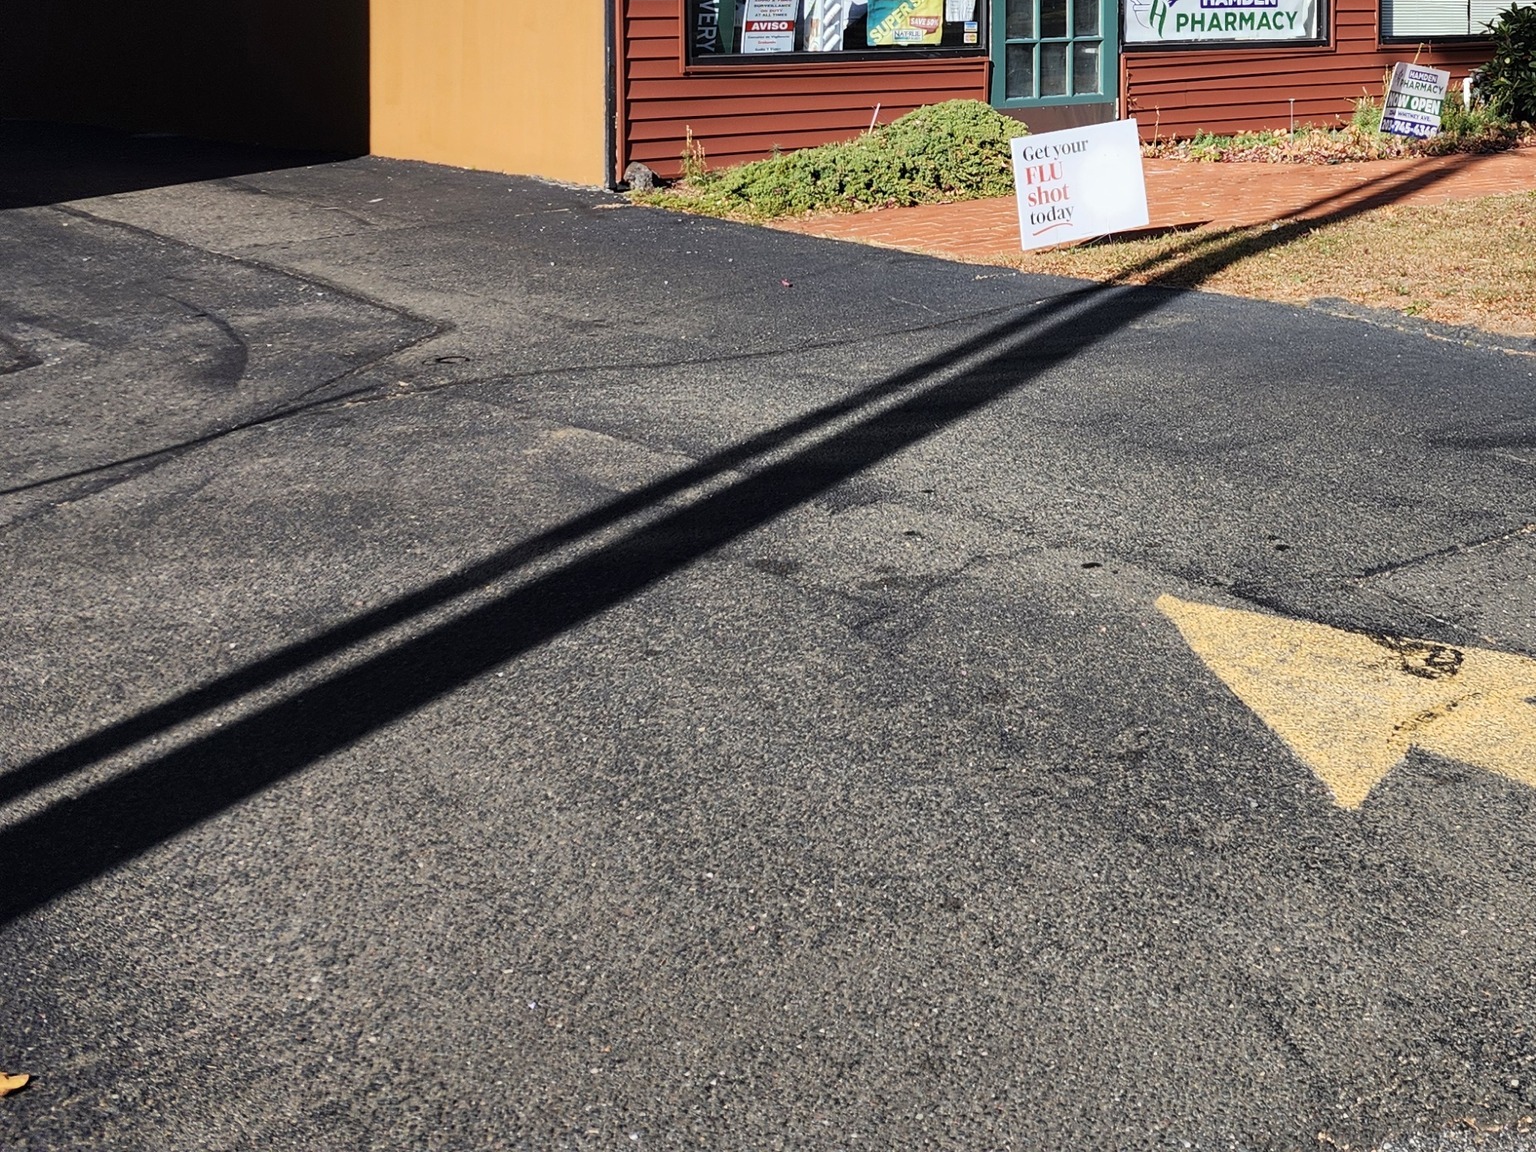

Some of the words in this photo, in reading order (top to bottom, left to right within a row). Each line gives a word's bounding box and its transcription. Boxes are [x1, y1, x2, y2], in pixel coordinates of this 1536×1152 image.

[752, 22, 788, 30] AVISO
[870, 2, 912, 43] SUPER
[1176, 11, 1298, 32] PHARMACY
[1400, 79, 1444, 94] PHARMACY
[1410, 71, 1437, 83] HAMDEN
[1388, 92, 1410, 108] NOW
[1411, 97, 1440, 115] OPEN
[1398, 111, 1419, 119] WHITNEY
[1023, 145, 1050, 162] Get
[1053, 140, 1088, 160] your
[1025, 162, 1064, 185] FLU
[1028, 184, 1070, 207] shot
[1030, 206, 1074, 225] today
